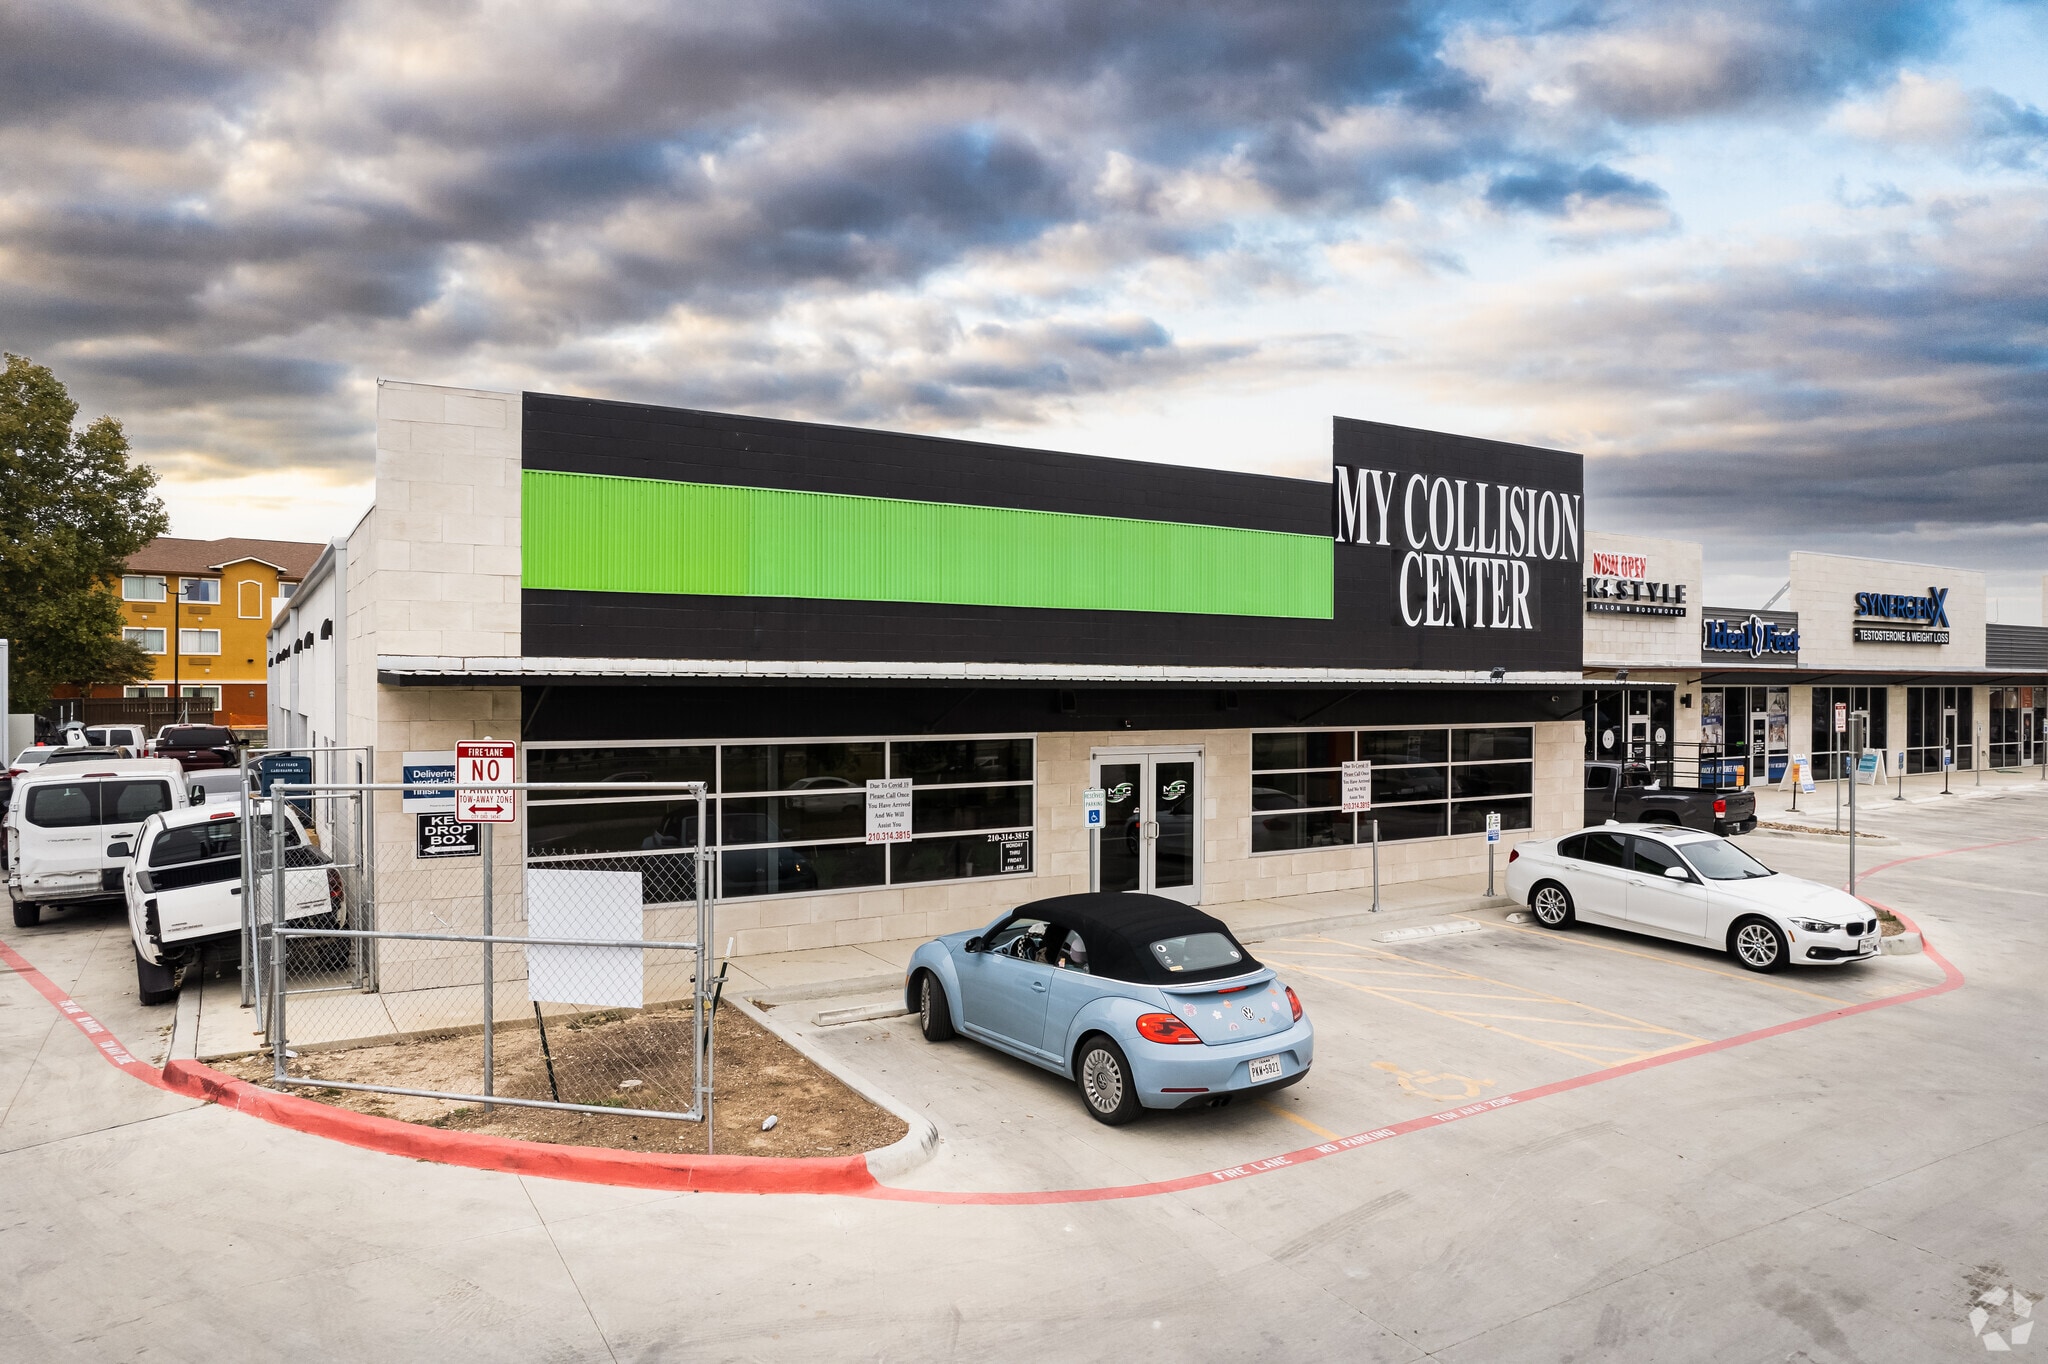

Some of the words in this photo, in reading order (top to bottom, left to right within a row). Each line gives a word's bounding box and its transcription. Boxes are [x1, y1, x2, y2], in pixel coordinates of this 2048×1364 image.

[1335, 465, 1396, 546] MY
[1404, 473, 1581, 562] COLLISION
[1593, 553, 1619, 576] NOW
[1621, 555, 1647, 578] OPEN
[1400, 551, 1533, 629] CENTER
[1594, 603, 1620, 611] SALON
[1636, 606, 1684, 615] BODYWORKS
[1704, 619, 1752, 651] Ideal
[1762, 622, 1800, 653] Feet
[1860, 630, 1906, 641] TESTOSTERONE
[1906, 631, 1911, 641] &
[1911, 632, 1933, 642] WEIGHT
[1934, 633, 1949, 643] LOSS
[468, 748, 483, 757] FIRE
[484, 748, 503, 757] LANE
[413, 770, 456, 779] Delivering
[472, 759, 500, 781] NO
[460, 795, 493, 804] TOW-AWAY
[496, 795, 512, 804] ZONE
[431, 816, 455, 826] KE
[425, 825, 474, 836] DROP
[868, 830, 911, 842] 210.314.3815
[430, 835, 467, 845] BOX
[1212, 1166, 1252, 1181] FIRE
[1249, 1156, 1293, 1171] LANE
[1314, 1143, 1340, 1154] NO
[1338, 1128, 1397, 1148] PARKING
